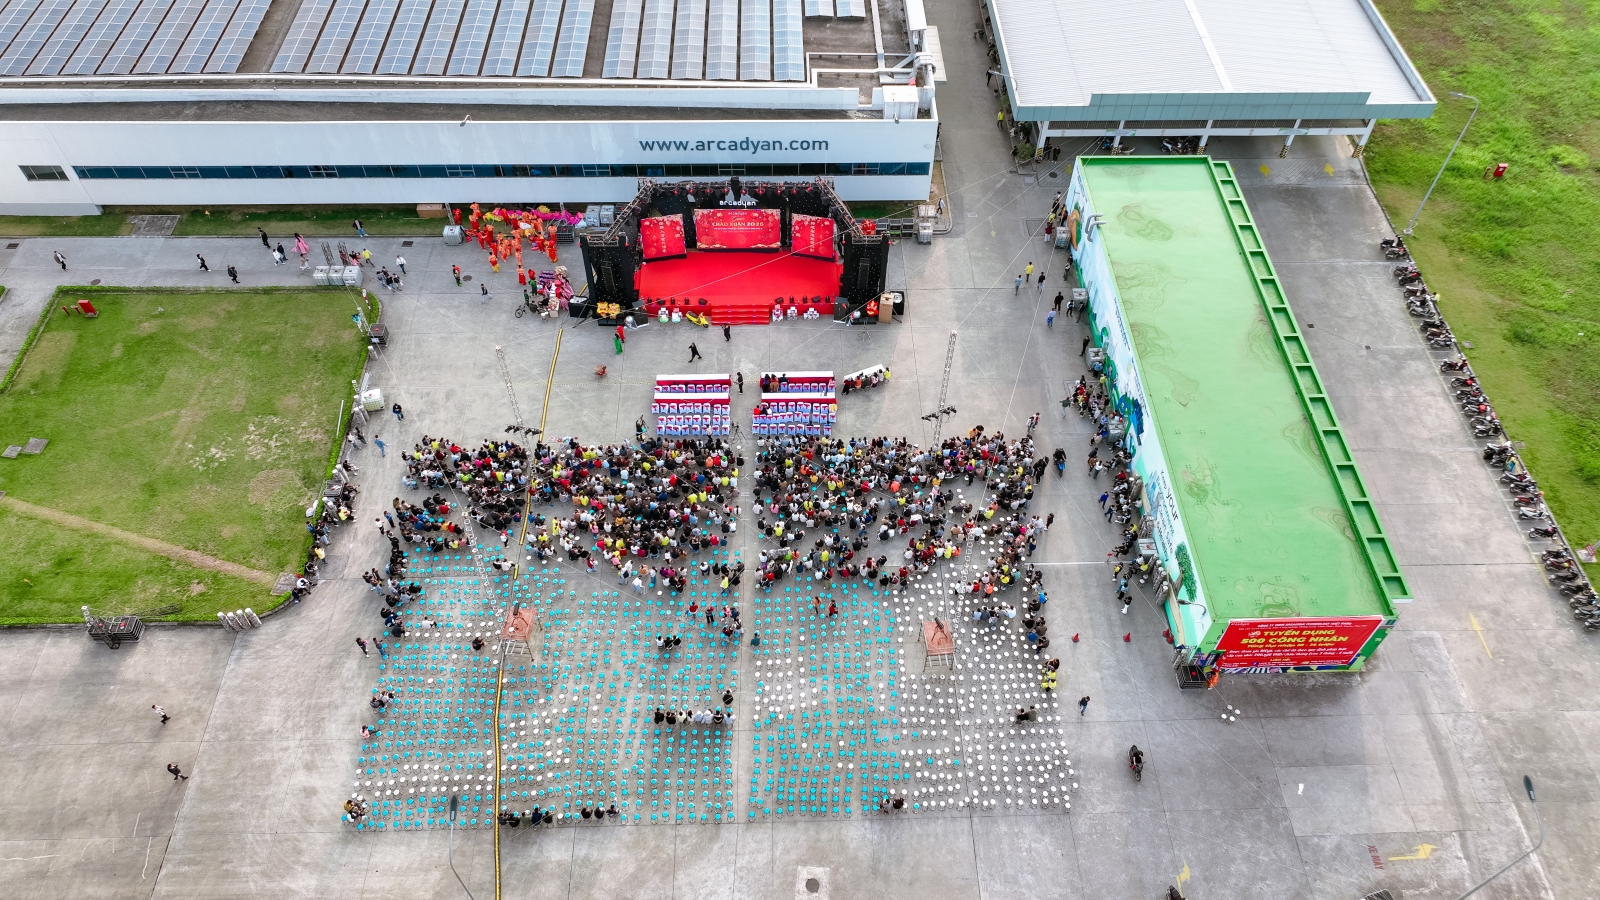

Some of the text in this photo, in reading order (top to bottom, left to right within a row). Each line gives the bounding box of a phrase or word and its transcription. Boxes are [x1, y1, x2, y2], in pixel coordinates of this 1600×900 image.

[639, 137, 829, 155] www.arcadyan.com
[719, 200, 757, 209] arcadyan
[1166, 487, 1179, 521] your
[1366, 844, 1379, 854] XE
